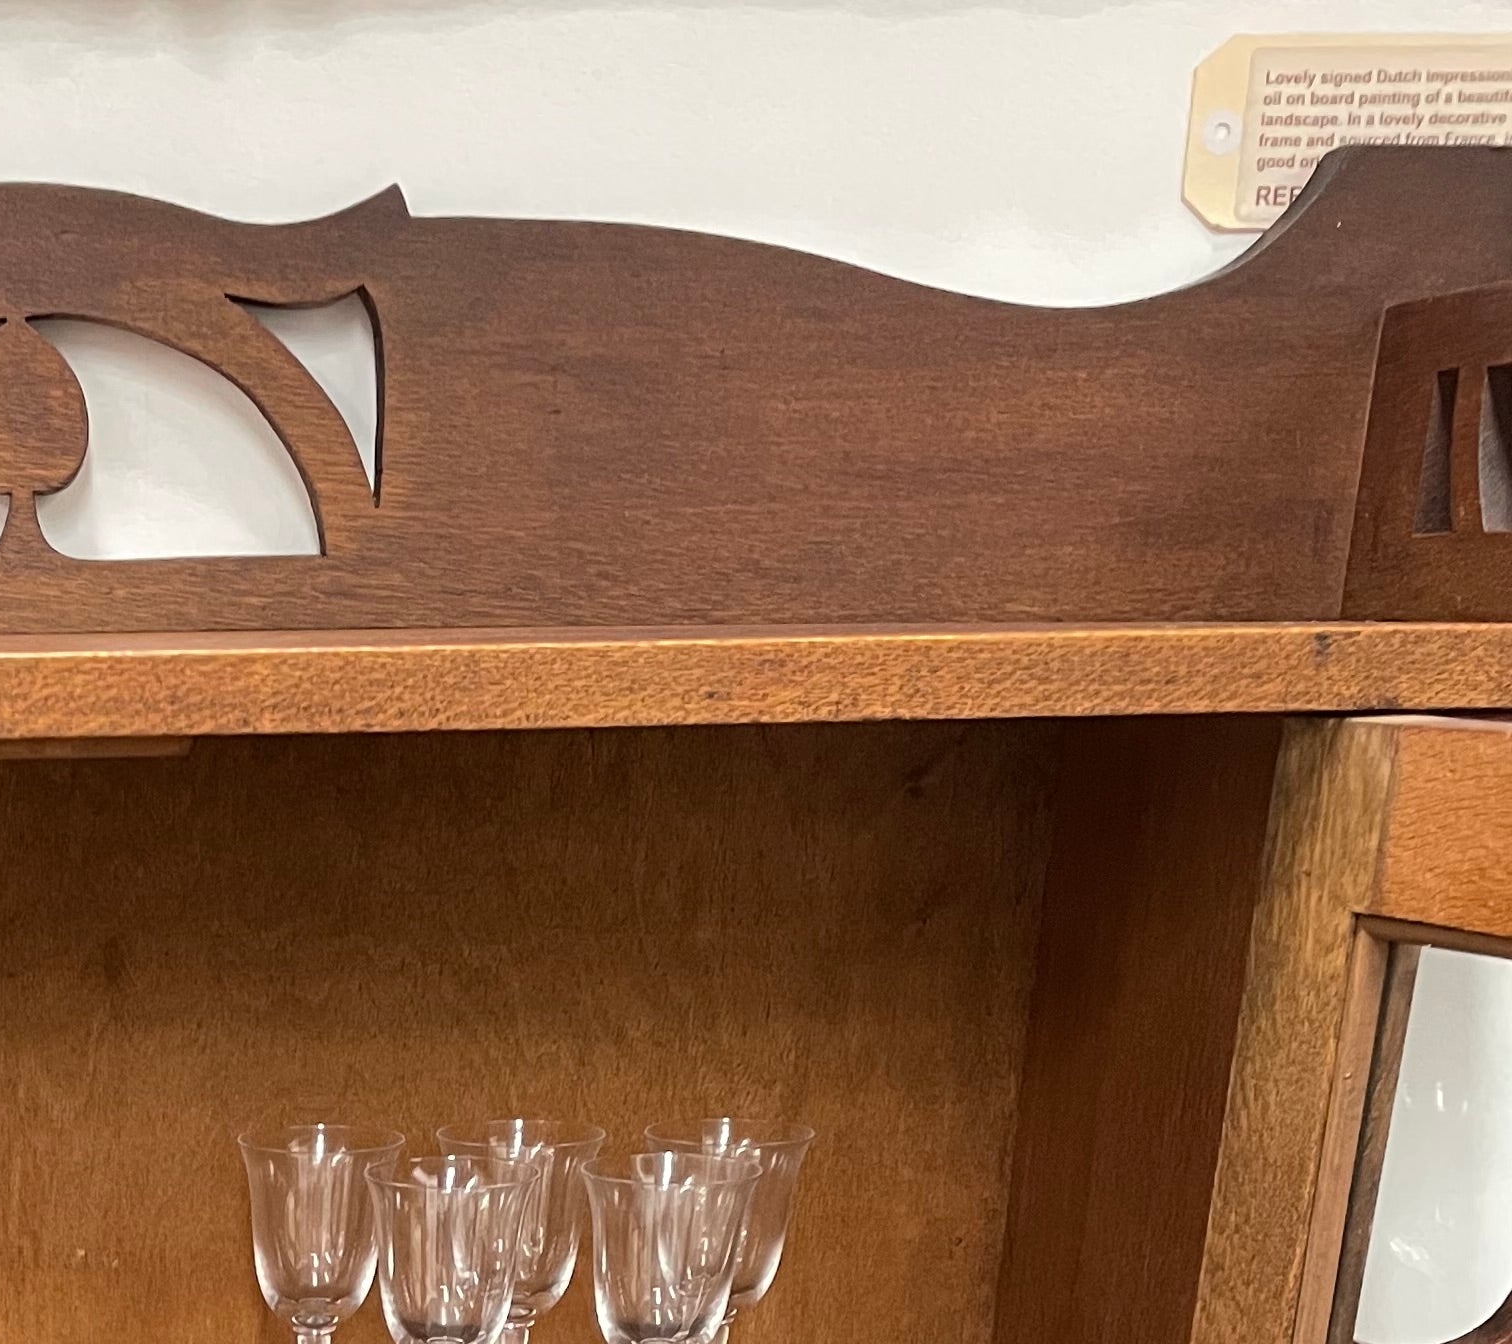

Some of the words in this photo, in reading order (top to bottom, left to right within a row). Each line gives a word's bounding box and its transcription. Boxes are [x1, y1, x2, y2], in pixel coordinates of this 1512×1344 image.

[1266, 69, 1316, 89] Lovely
[1320, 70, 1373, 87] signed
[1376, 69, 1422, 83] Dutch
[1426, 69, 1512, 86] impression
[1263, 91, 1281, 106] oil
[1286, 94, 1305, 105] on
[1311, 91, 1355, 106] board
[1358, 91, 1421, 108] painting
[1425, 88, 1441, 104] of
[1443, 93, 1453, 104] a
[1458, 89, 1512, 104] beautif
[1347, 111, 1361, 125] In
[1366, 115, 1375, 126] a
[1379, 111, 1424, 129] lovely
[1428, 112, 1507, 125] decorative
[1258, 133, 1302, 147] frame
[1306, 133, 1335, 147] and
[1405, 132, 1440, 146] from
[1256, 154, 1296, 172] good
